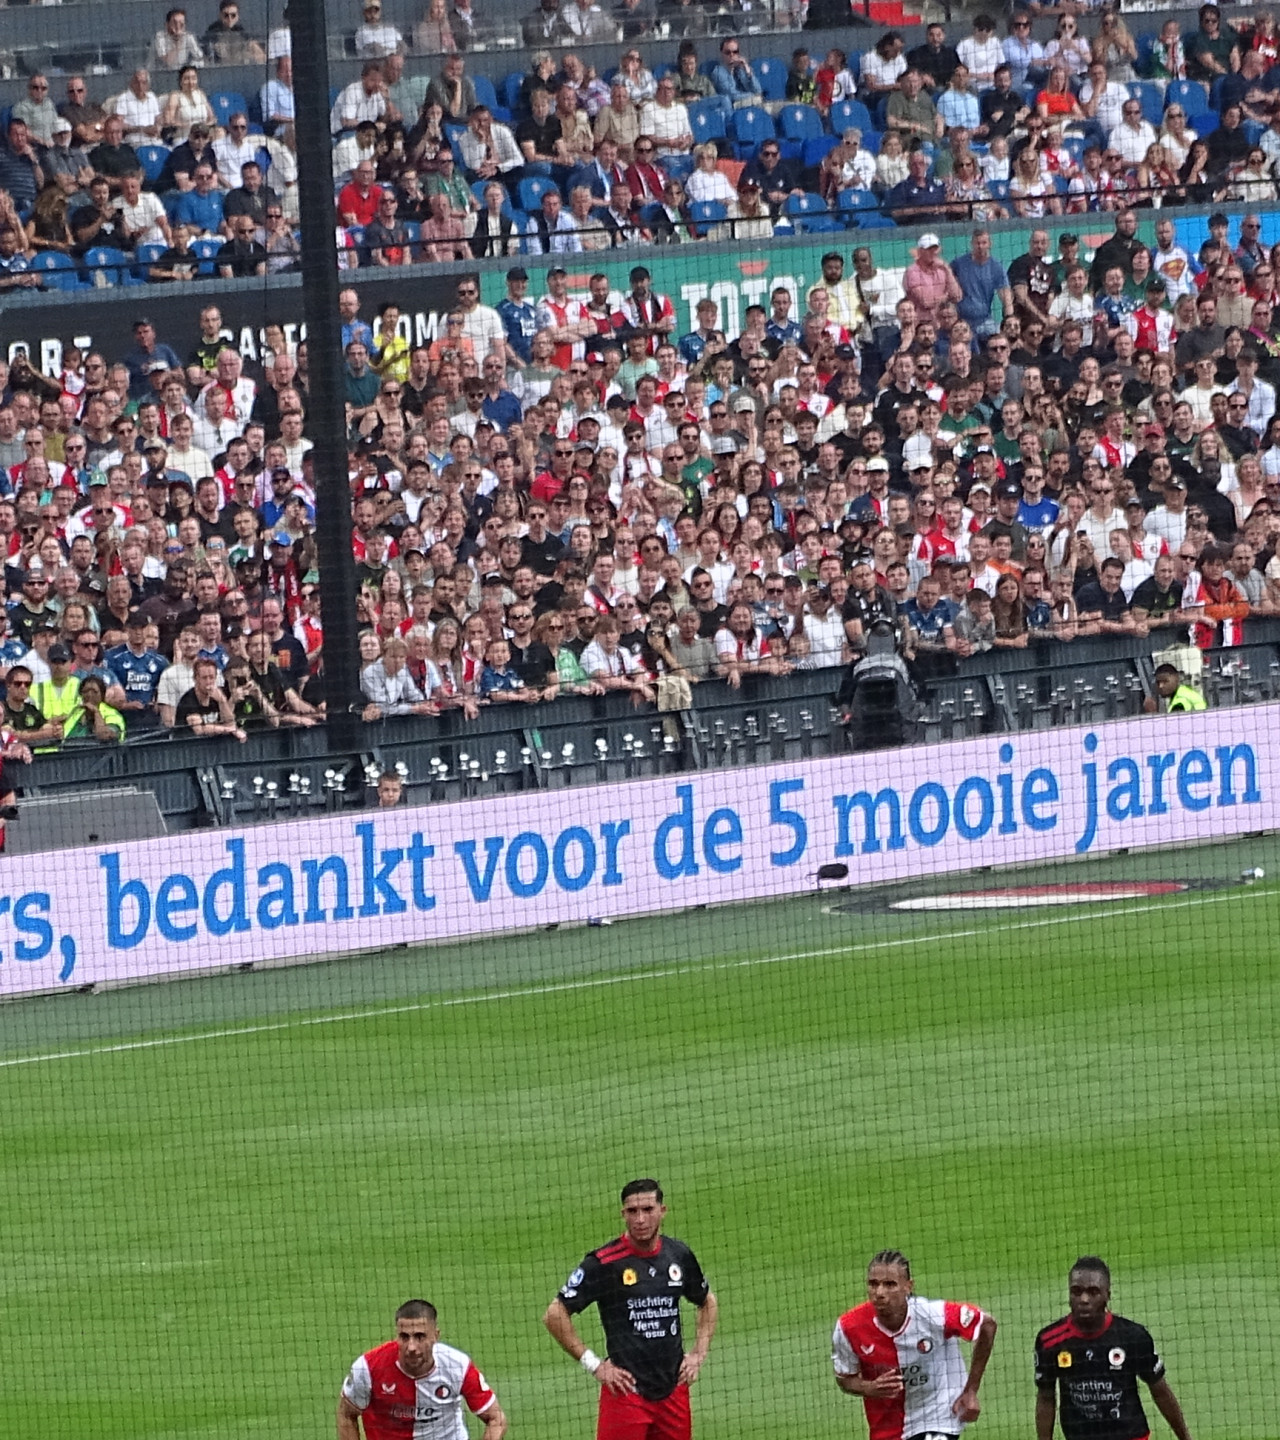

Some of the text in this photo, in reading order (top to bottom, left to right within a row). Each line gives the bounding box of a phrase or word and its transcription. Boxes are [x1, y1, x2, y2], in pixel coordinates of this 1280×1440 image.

[98, 820, 438, 950] bedankt
[452, 818, 632, 903] voor
[651, 783, 745, 881] de
[767, 777, 809, 868] 5
[831, 741, 1061, 858] mooie
[1073, 731, 1263, 855] jaren
[626, 1296, 673, 1310] Stichting
[1068, 1380, 1112, 1392] tichting
